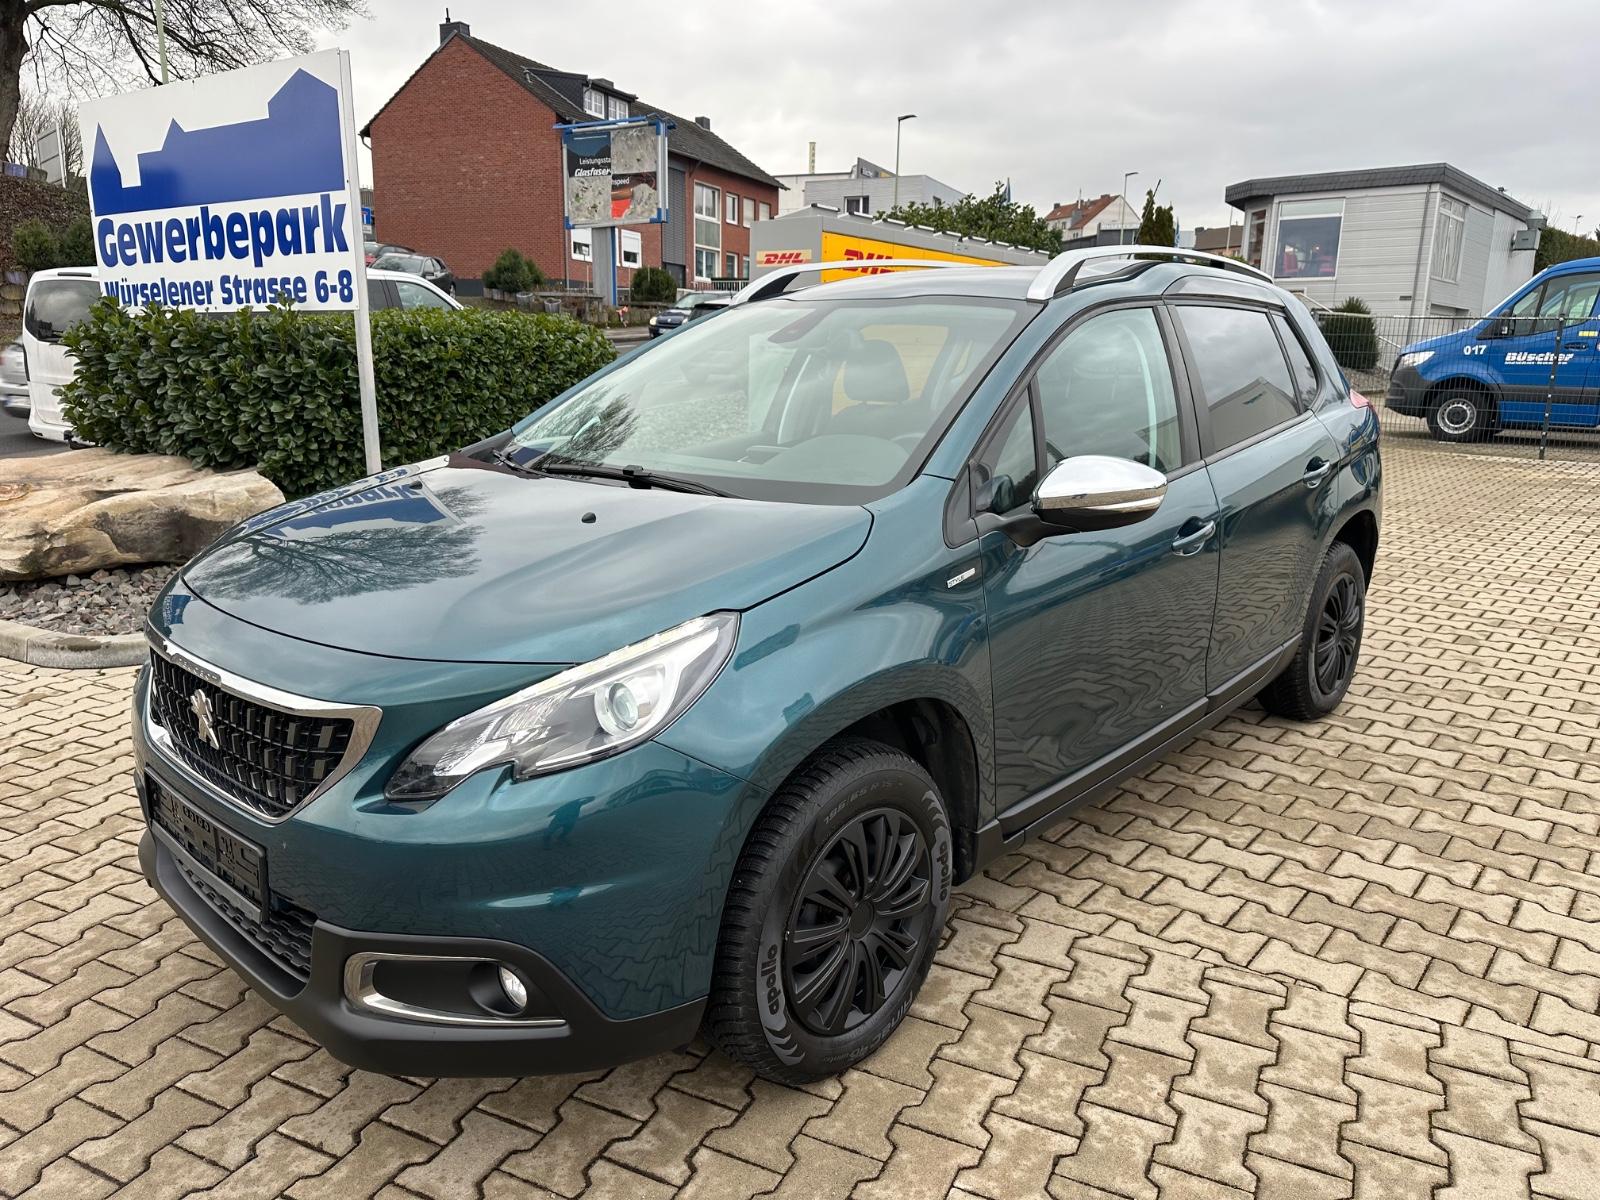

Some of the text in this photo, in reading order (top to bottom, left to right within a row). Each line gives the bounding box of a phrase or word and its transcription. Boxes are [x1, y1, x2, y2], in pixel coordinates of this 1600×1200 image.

[97, 193, 349, 267] Gewerbepark
[764, 252, 803, 265] DHL
[104, 269, 353, 306] Würselener Strasse 6-8
[1463, 345, 1487, 355] 017
[936, 840, 950, 902] apollo
[761, 944, 782, 1015] apollo
